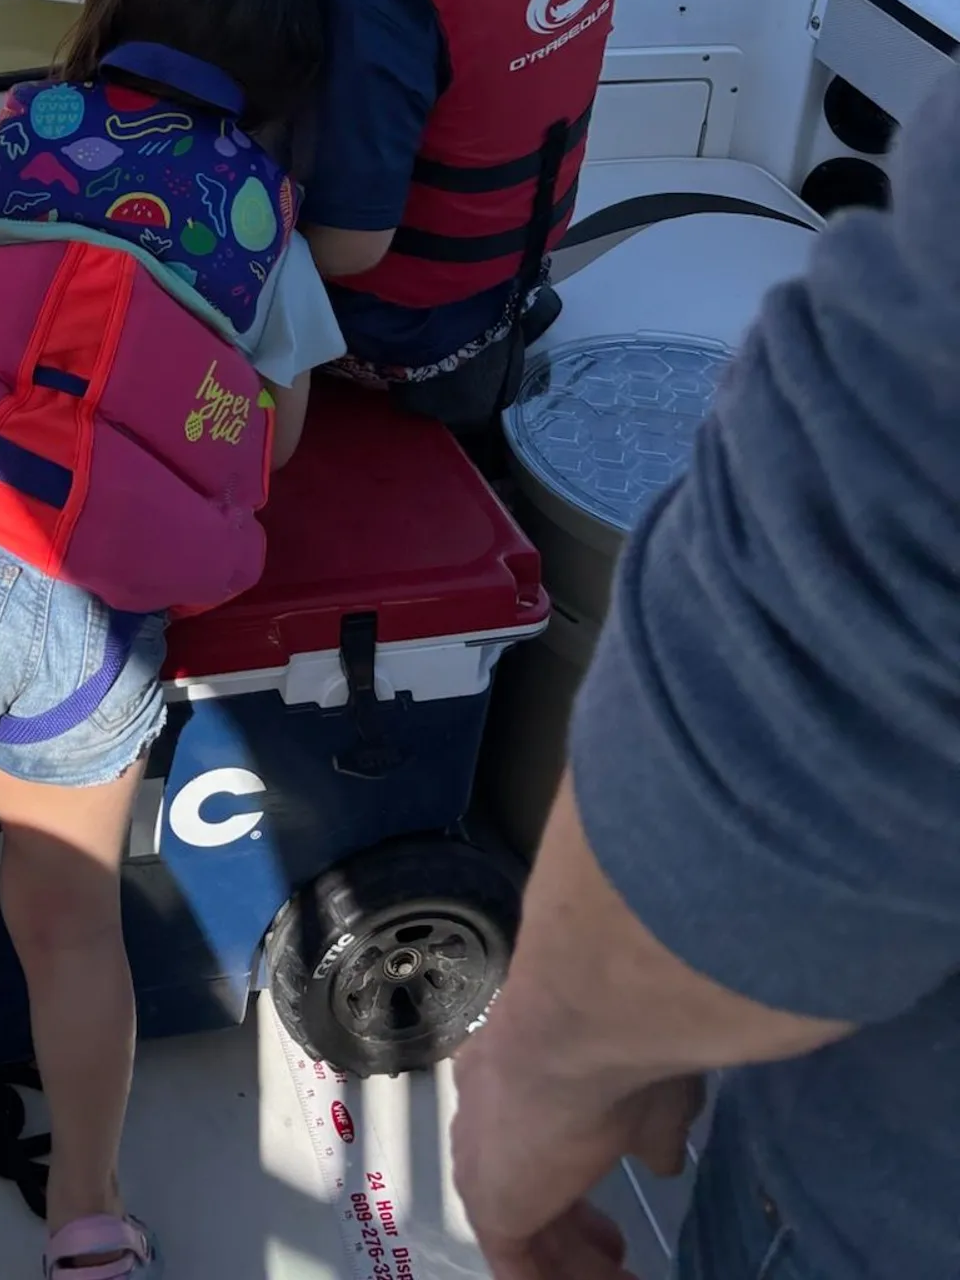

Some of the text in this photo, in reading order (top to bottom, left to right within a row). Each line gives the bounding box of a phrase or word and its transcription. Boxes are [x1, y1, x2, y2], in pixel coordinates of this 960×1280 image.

[333, 1103, 353, 1141] VHF 16
[297, 1060, 363, 1252] 10 11 12 13 14 15 16
[366, 1171, 386, 1191] 24
[375, 1200, 399, 1237] Hour
